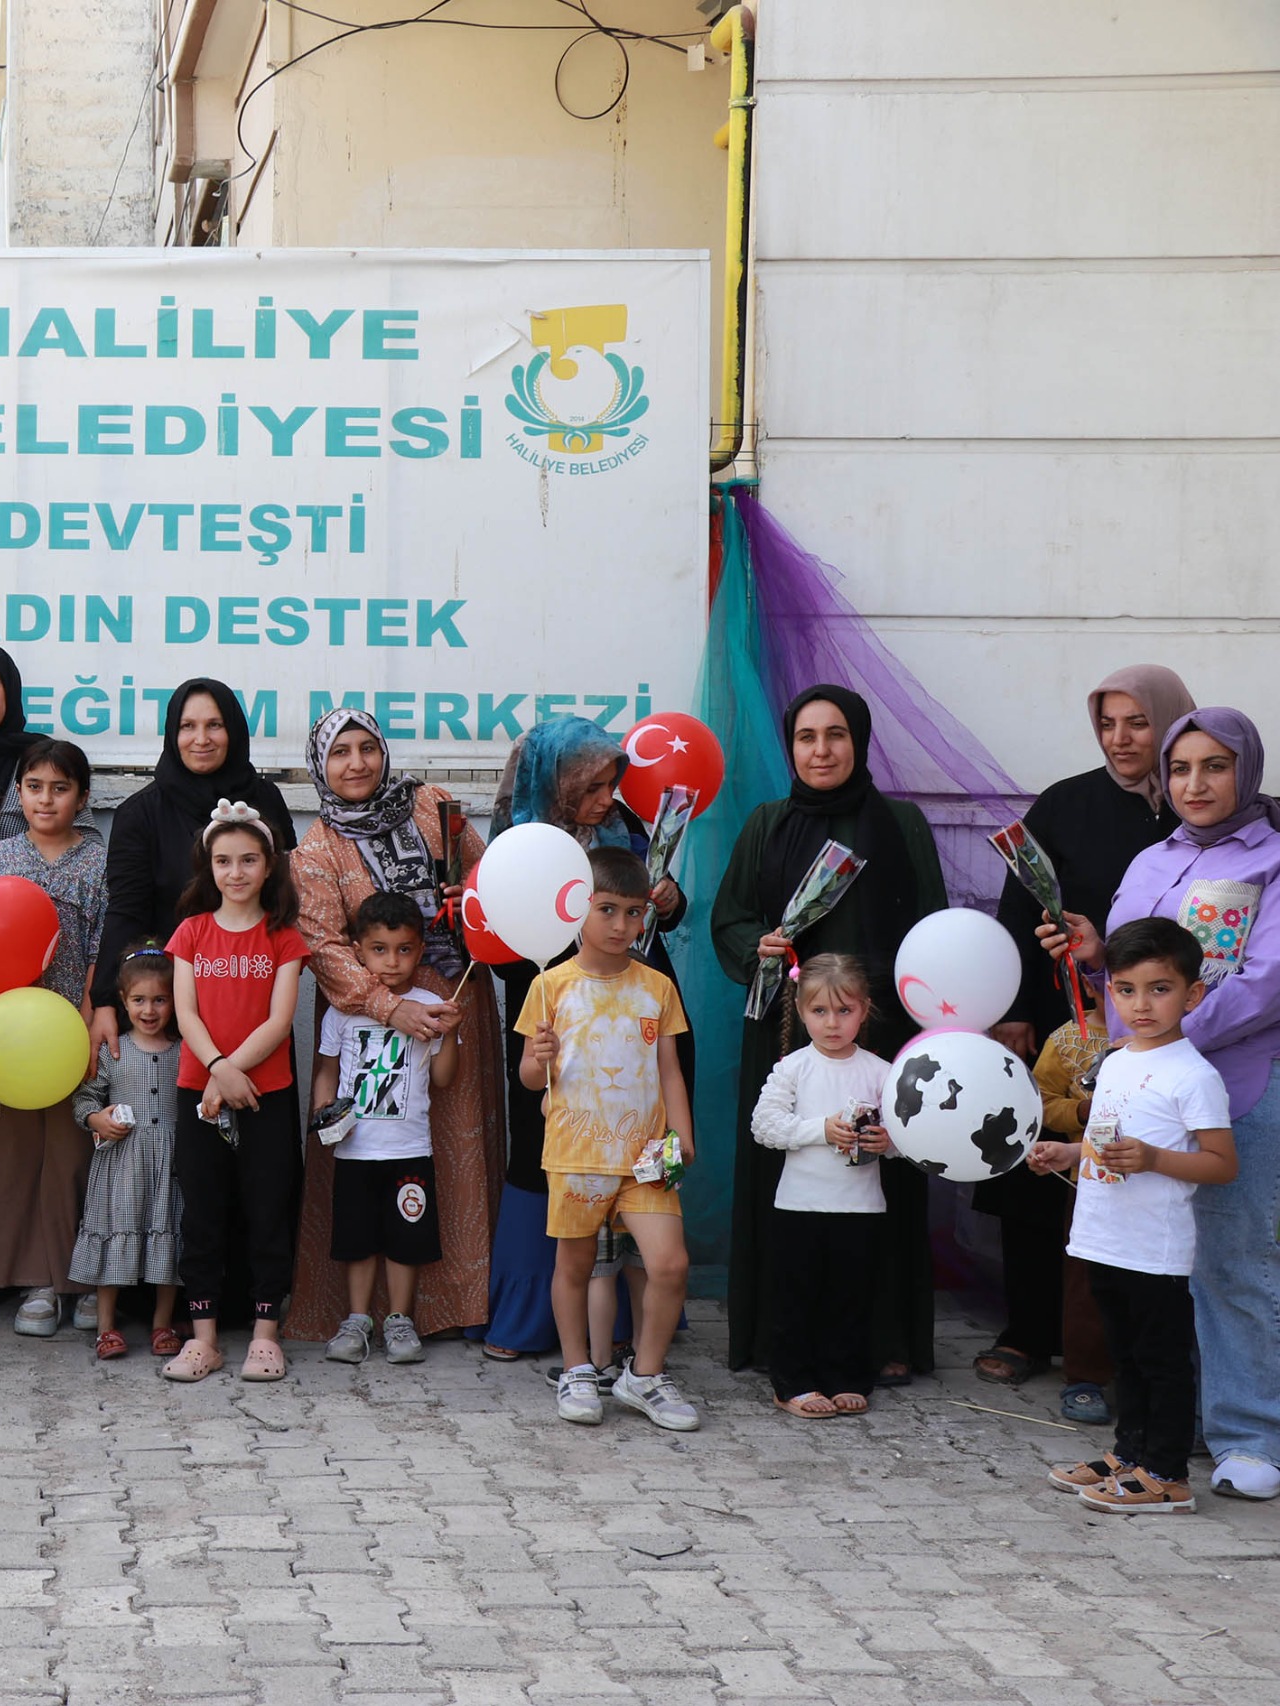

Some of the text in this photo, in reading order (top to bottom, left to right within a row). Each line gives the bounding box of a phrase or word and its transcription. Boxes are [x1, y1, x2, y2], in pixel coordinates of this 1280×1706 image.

[505, 432, 650, 476] HALİLİYE BELEDİYESİ
[164, 595, 468, 648] DESTEK
